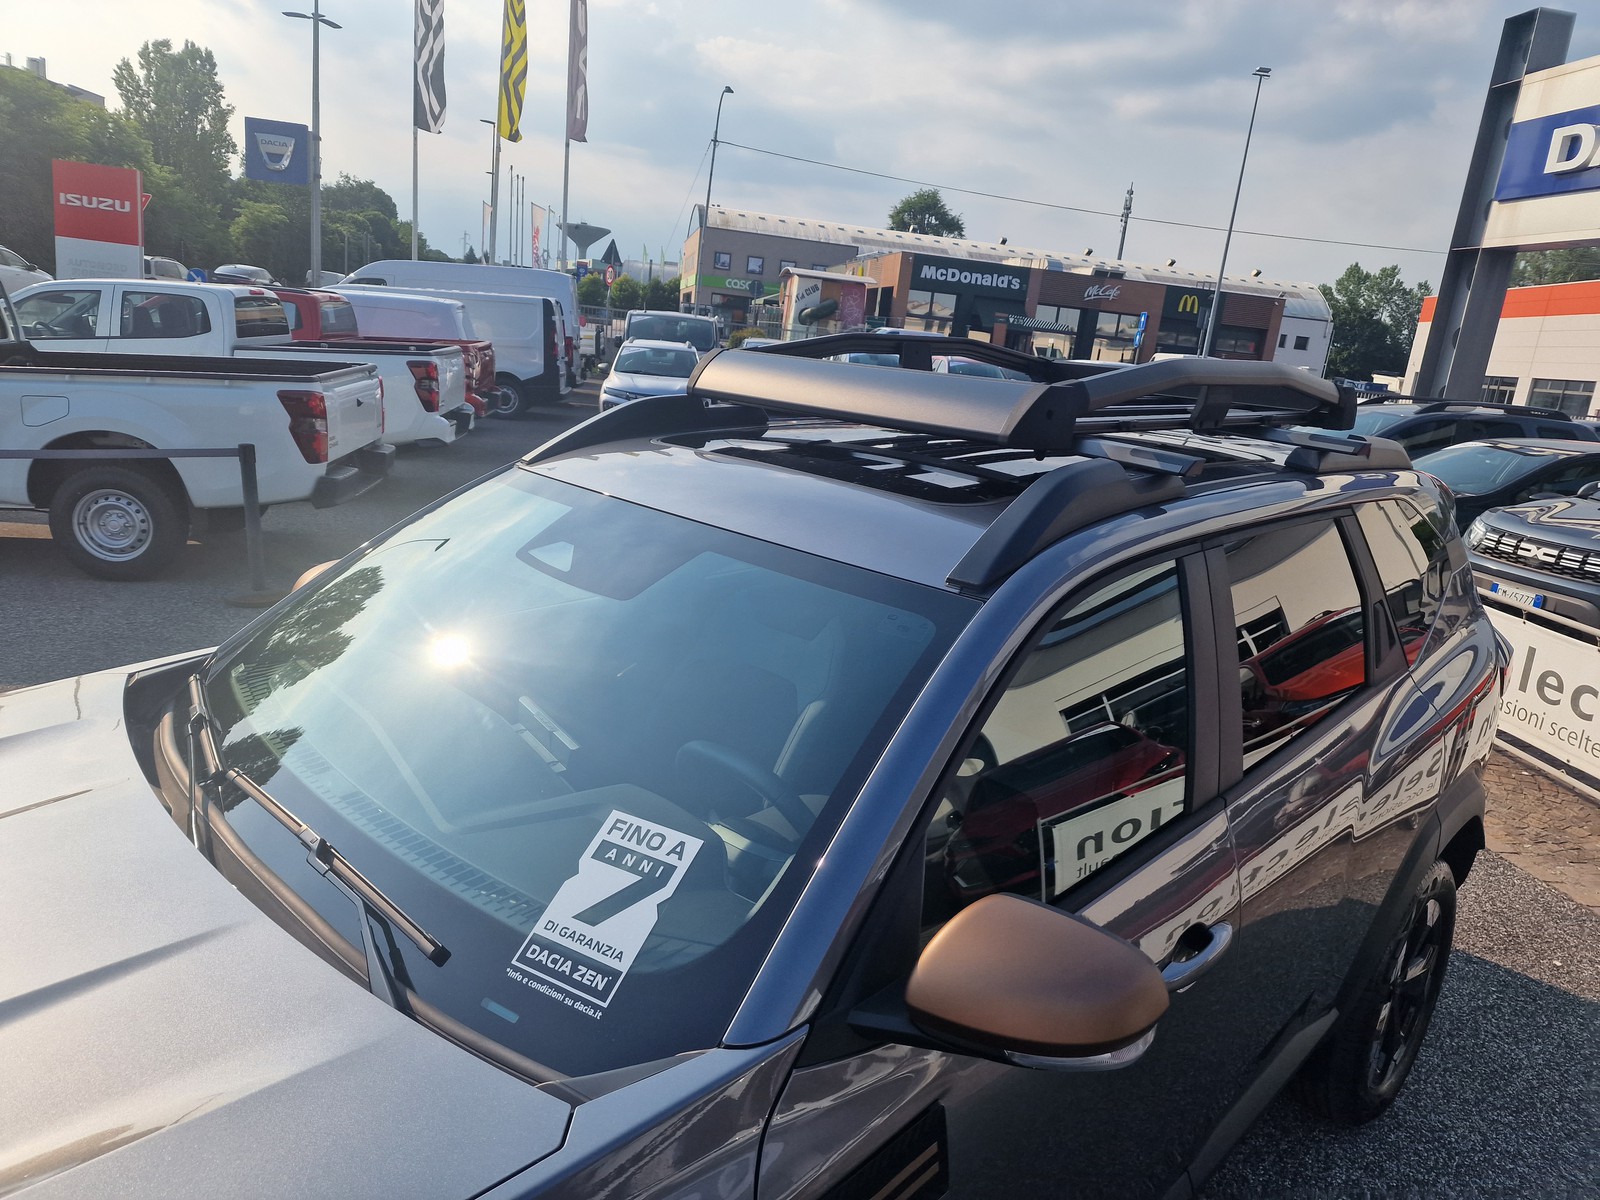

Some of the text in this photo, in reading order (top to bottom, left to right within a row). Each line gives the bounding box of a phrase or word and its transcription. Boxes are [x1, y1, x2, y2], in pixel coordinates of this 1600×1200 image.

[260, 138, 288, 148] DACIA
[59, 192, 131, 213] ISUZU
[920, 265, 1021, 290] McDonald's
[1547, 721, 1600, 759] scelte
[606, 818, 686, 861] FINO A
[604, 848, 664, 878] ANNI
[543, 919, 624, 963] DI GARANZIA
[525, 944, 572, 976] DACIA
[528, 979, 566, 1002] condizioni
[564, 996, 574, 1007] su
[573, 1000, 603, 1020] dacia.it
